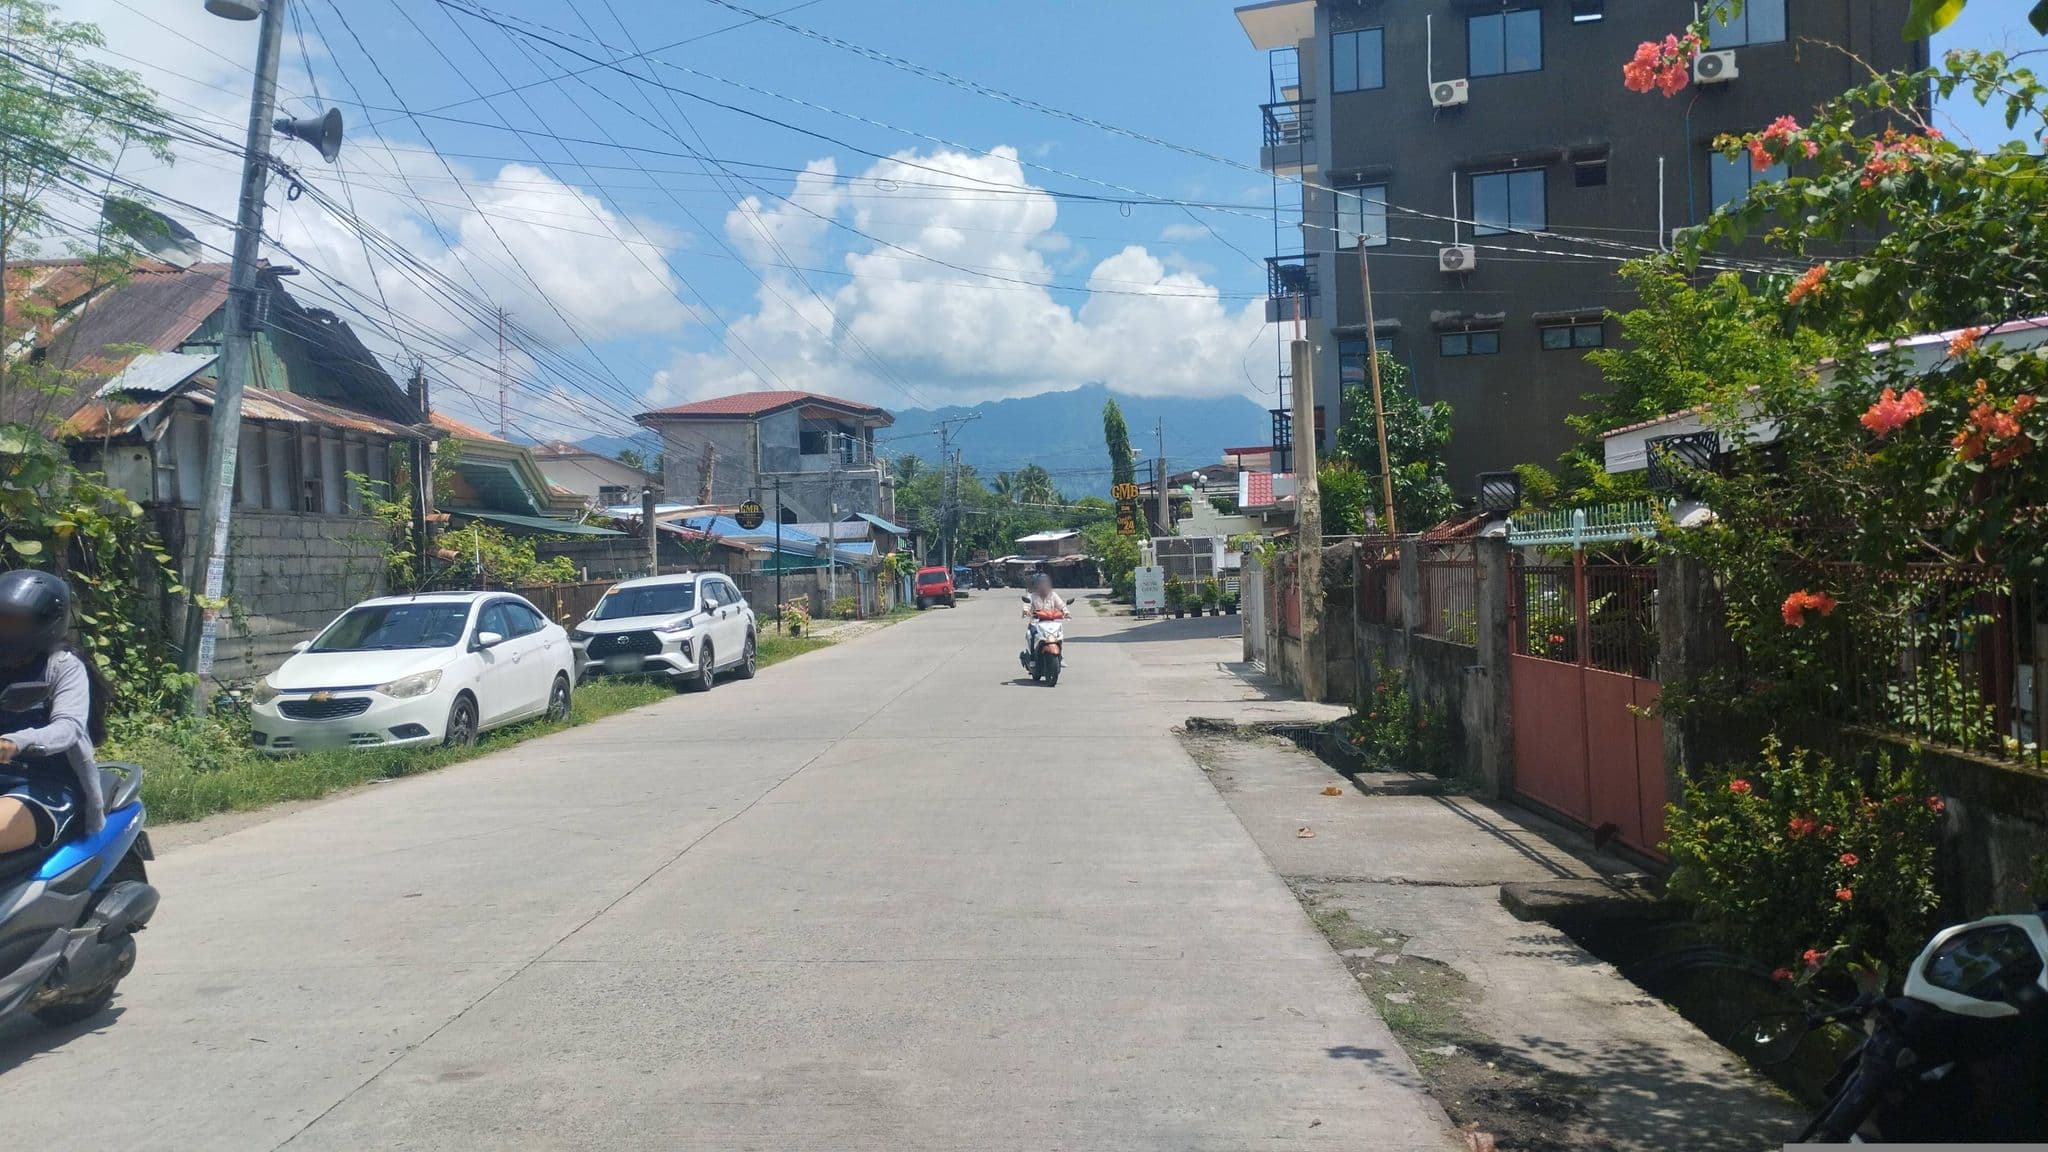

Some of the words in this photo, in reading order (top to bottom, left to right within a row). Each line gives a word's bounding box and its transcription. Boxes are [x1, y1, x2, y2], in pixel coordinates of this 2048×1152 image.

[1112, 483, 1139, 500] GMB
[741, 504, 759, 513] GMB
[1124, 519, 1134, 529] 24
